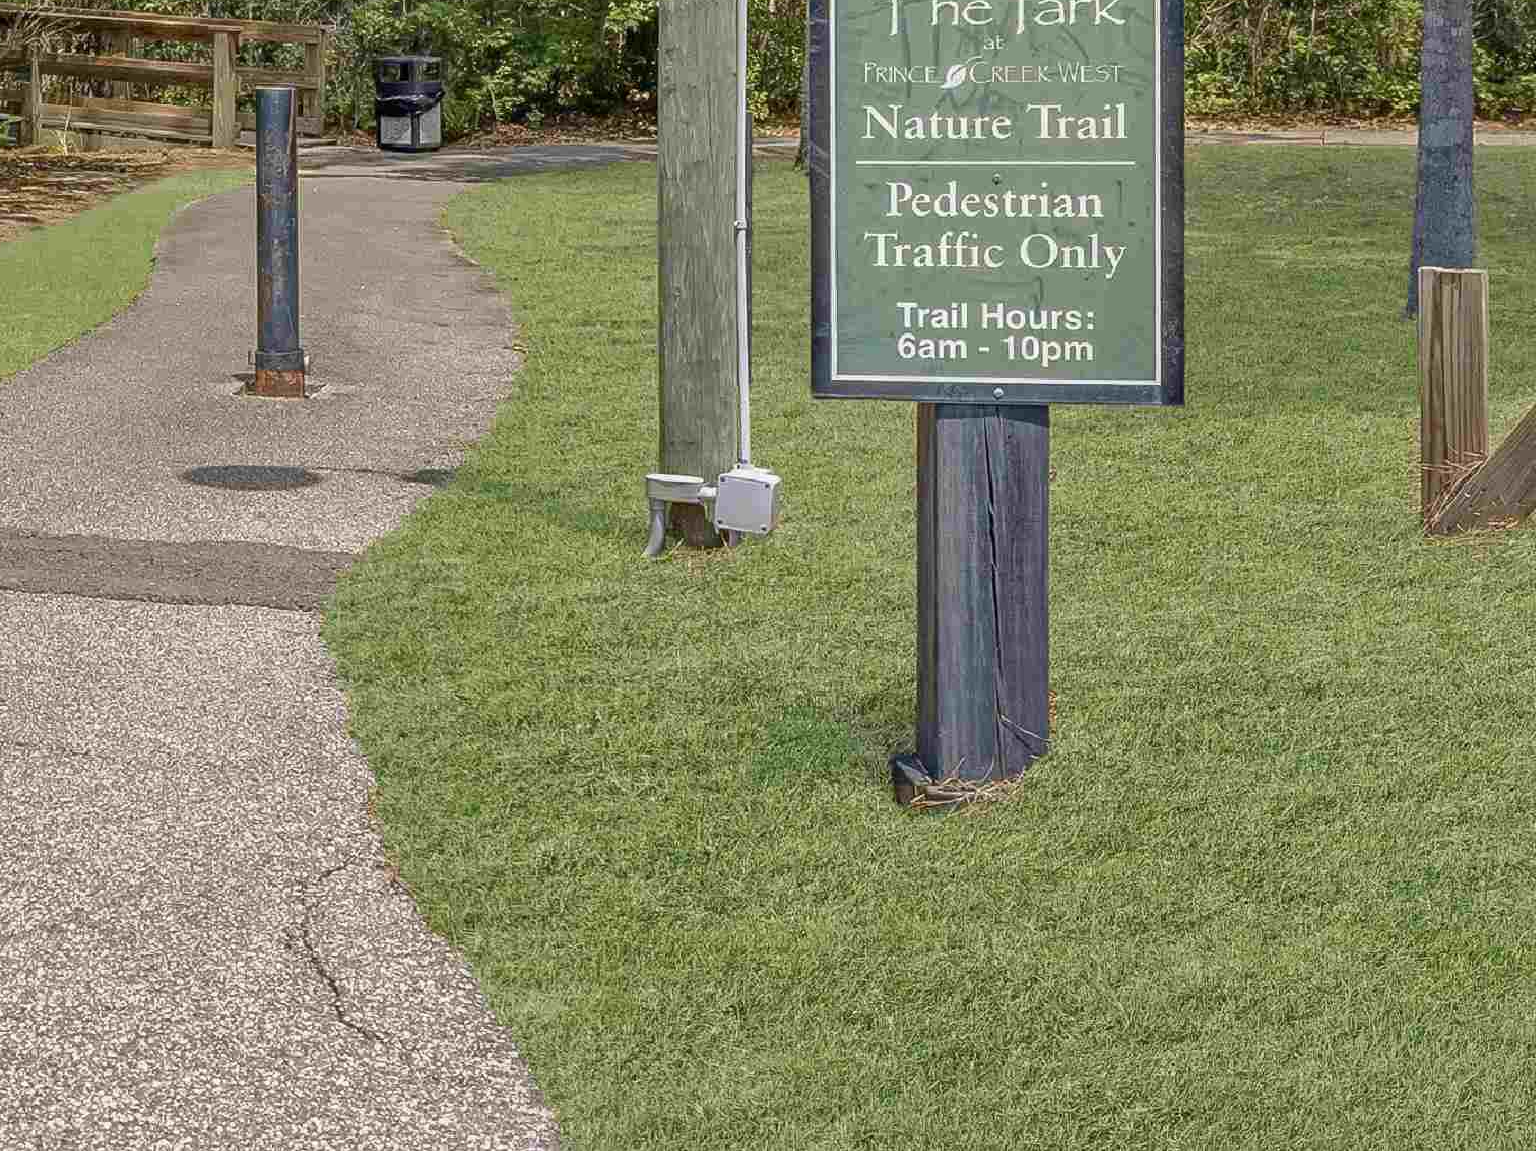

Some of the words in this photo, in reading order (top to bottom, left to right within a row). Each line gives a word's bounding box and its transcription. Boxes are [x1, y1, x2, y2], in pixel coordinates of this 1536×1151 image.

[983, 36, 1005, 50] at
[864, 61, 937, 83] PRINCE
[968, 57, 1052, 84] CREEK
[1057, 64, 1125, 83] WEST
[861, 104, 1013, 140] Nature
[1026, 102, 1128, 140] Trail
[884, 180, 1104, 218] Pedestrian
[864, 231, 1005, 268] Traffic
[1020, 233, 1128, 279] Only
[896, 302, 968, 328] Trail
[980, 303, 1096, 330] Hours:
[896, 332, 968, 359] 6am
[1002, 335, 1094, 368] 10pm
